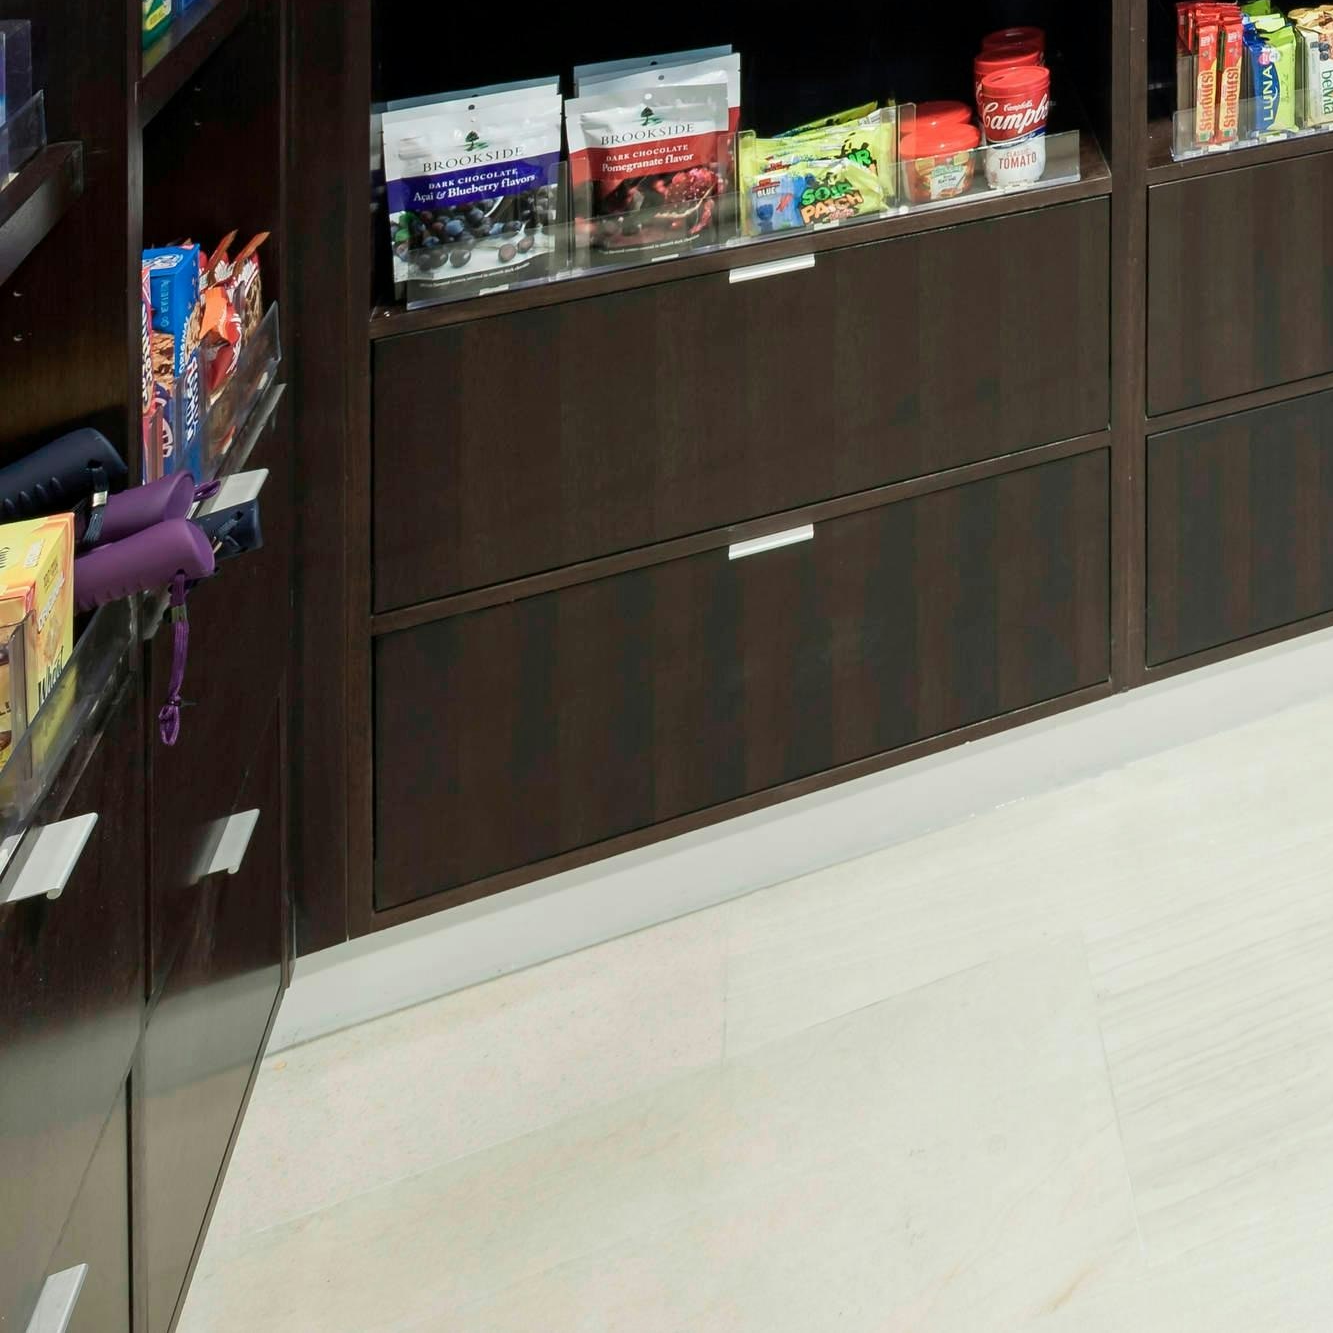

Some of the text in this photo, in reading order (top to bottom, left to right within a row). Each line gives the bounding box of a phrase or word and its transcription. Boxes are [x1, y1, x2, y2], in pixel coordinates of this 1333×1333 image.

[1199, 70, 1215, 132] Starburst
[1223, 66, 1240, 128] Starburst
[1263, 65, 1273, 122] LUNA
[601, 123, 695, 146] BROOKSIDE
[422, 147, 523, 173] BROOKSIDE
[602, 152, 694, 174] Pomegranate flavor
[606, 144, 689, 162] DARK CHOCOLATE
[998, 153, 1037, 170] TOMATO
[413, 173, 535, 203] Açai Blueberry flavors
[428, 169, 518, 190] DARK CHOCOLATE
[757, 187, 776, 197] BLUE
